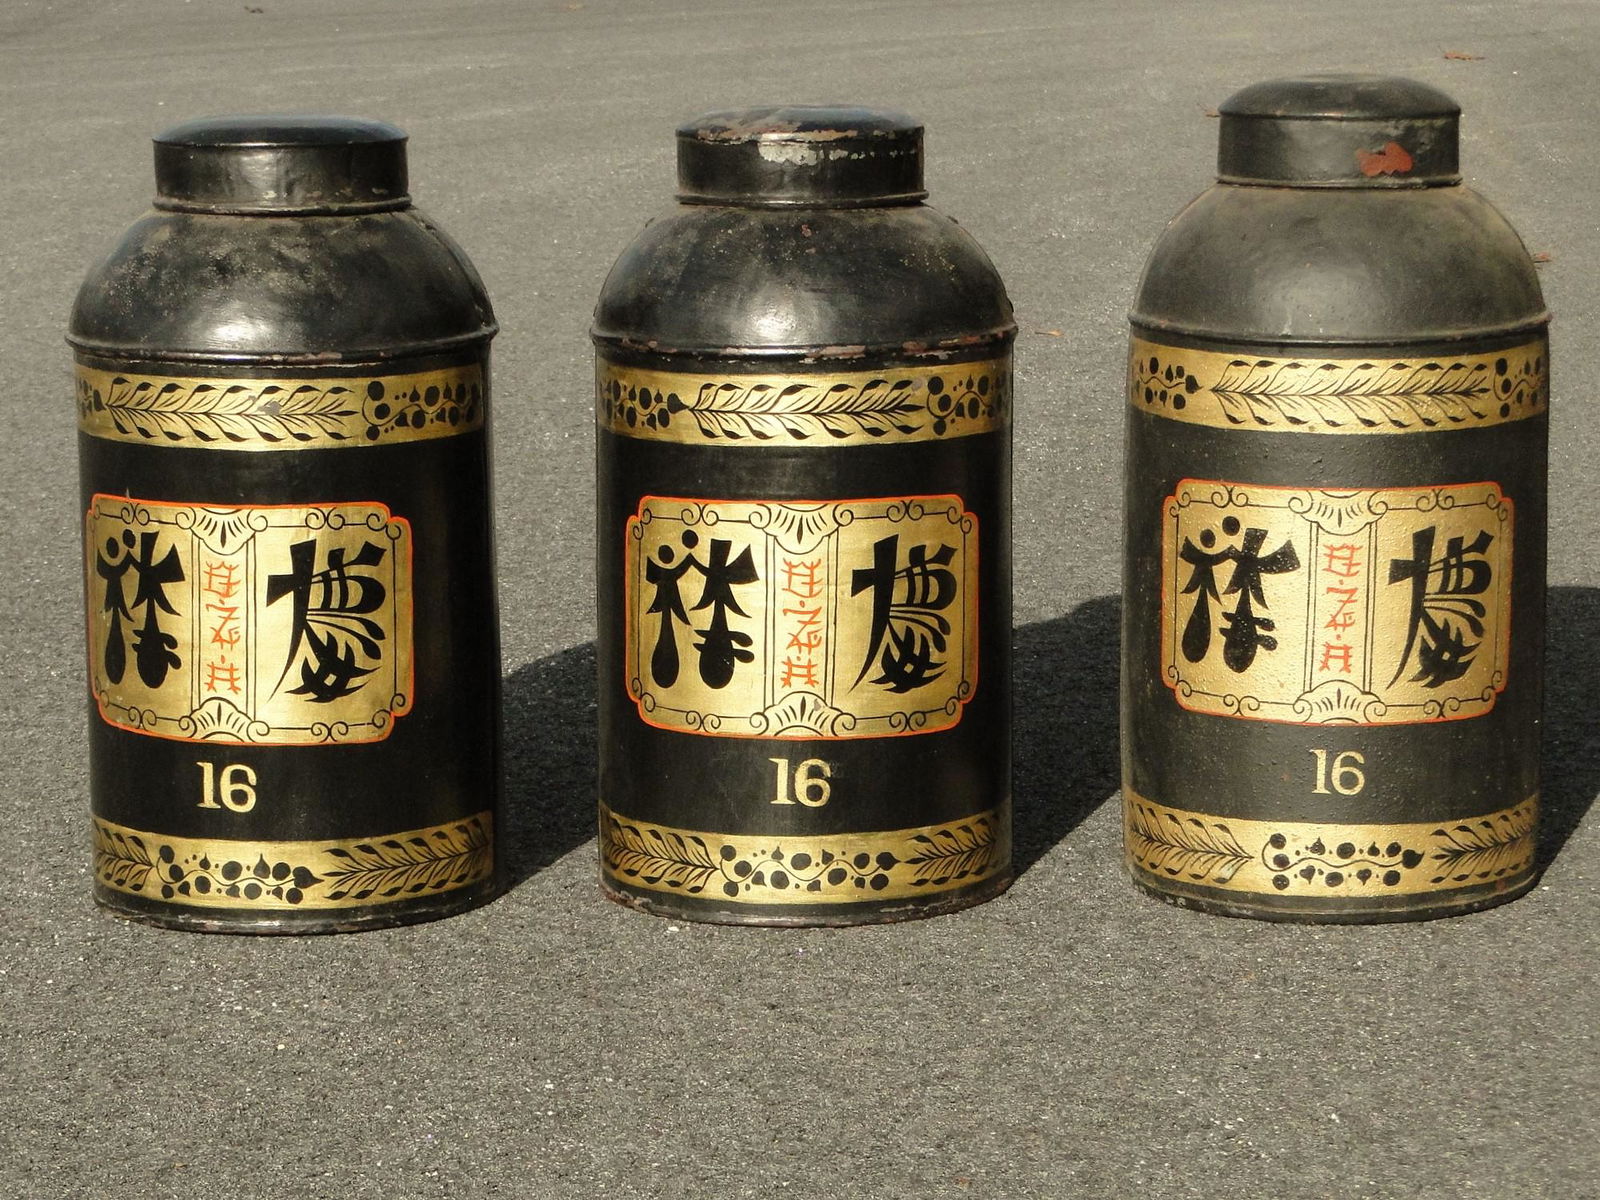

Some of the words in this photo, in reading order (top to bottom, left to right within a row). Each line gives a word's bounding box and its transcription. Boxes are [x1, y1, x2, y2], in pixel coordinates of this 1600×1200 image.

[196, 761, 258, 813] 16
[769, 757, 832, 808] 16
[1309, 748, 1366, 796] 16
